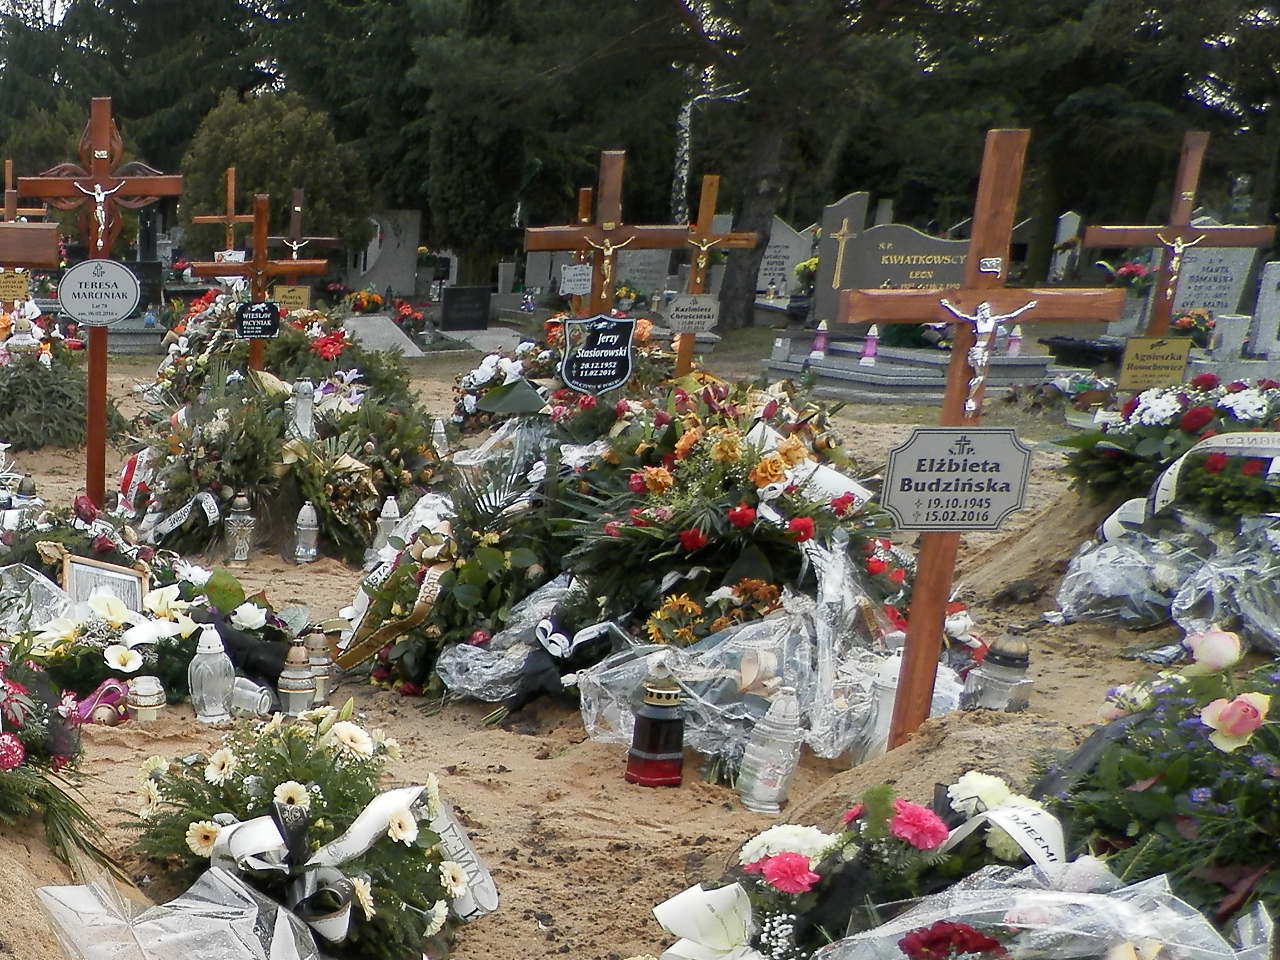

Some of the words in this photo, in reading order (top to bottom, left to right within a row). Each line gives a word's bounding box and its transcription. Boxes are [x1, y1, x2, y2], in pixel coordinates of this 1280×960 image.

[880, 255, 966, 265] KWIATKOWSCY
[909, 271, 934, 279] LEON
[78, 281, 118, 290] TERESA
[71, 291, 128, 300] MARCINIAK
[597, 333, 619, 345] Jerzy
[576, 346, 627, 358] Stasiorowski
[916, 458, 1000, 473] Elżbieta
[900, 478, 1011, 493] Budzińska
[927, 498, 991, 509] 19.10.1945
[925, 511, 989, 522] 15.02.2016
